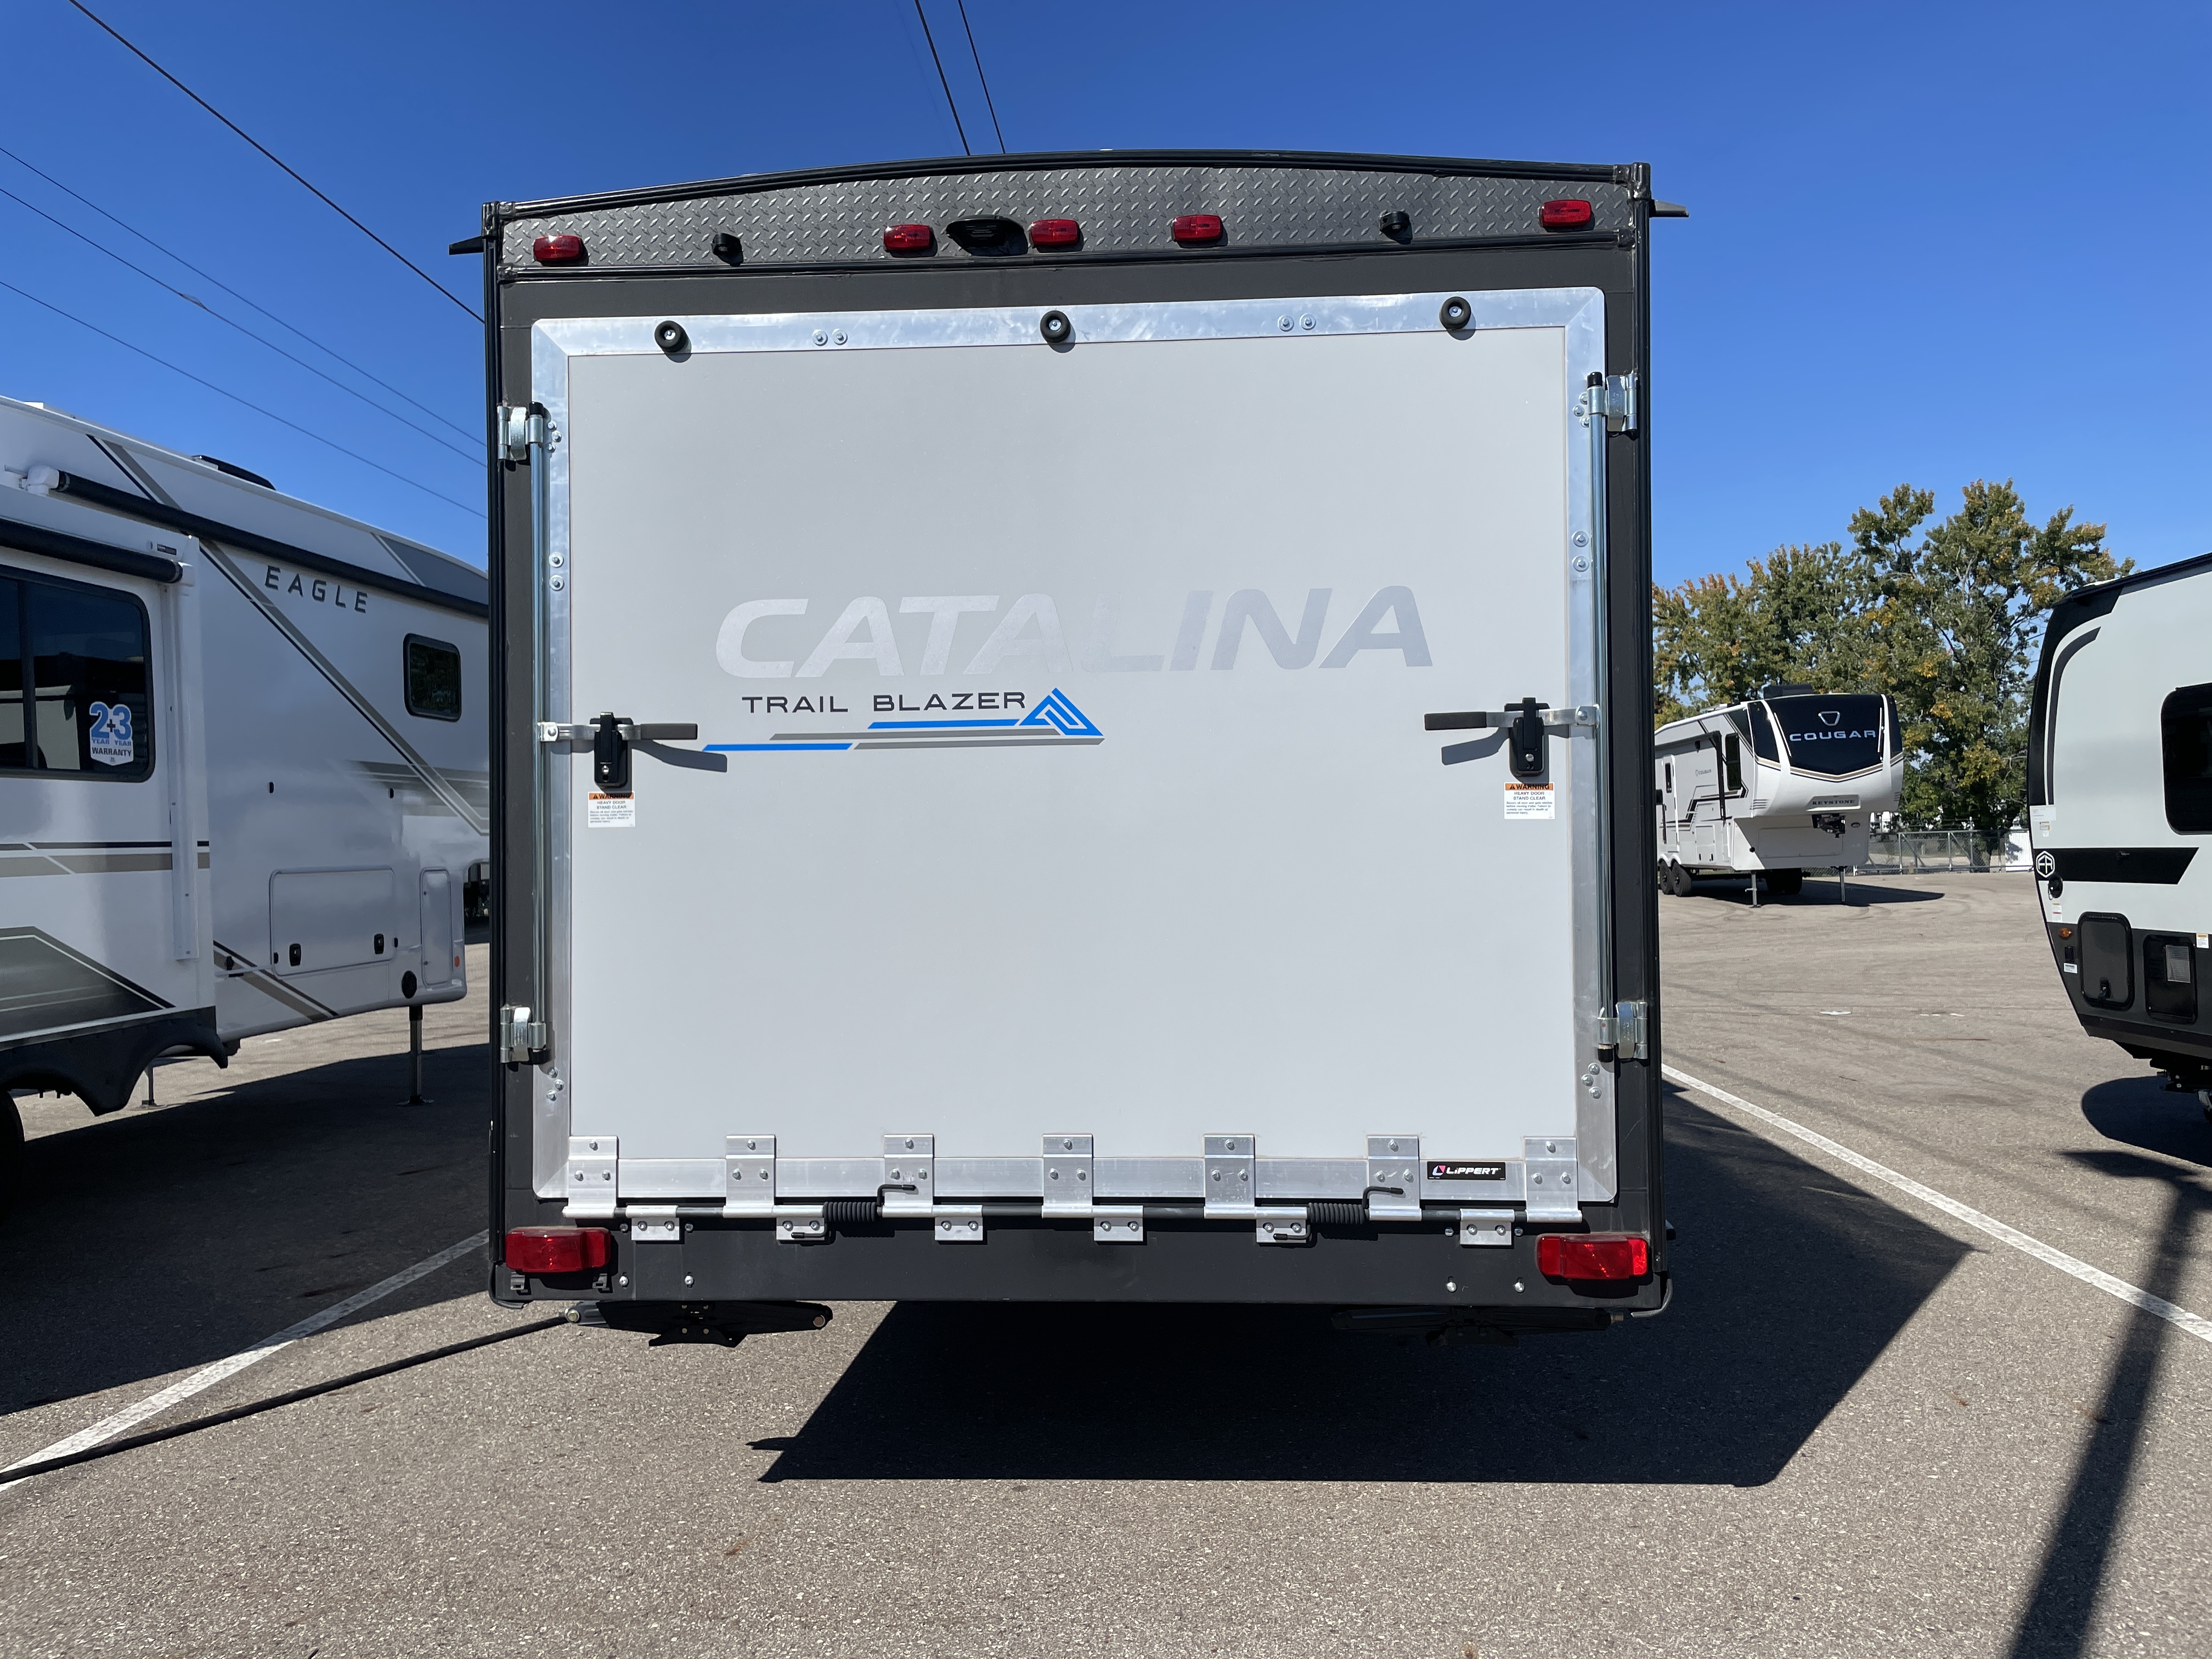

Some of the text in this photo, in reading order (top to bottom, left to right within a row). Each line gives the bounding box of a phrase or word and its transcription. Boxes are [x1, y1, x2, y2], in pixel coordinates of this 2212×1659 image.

[264, 565, 368, 614] EAGLE
[714, 585, 1433, 679] CATALINA
[741, 692, 1026, 713] TRAIL BLAZER
[1789, 730, 1876, 741] COUGAR
[92, 747, 132, 757] WARRANTY
